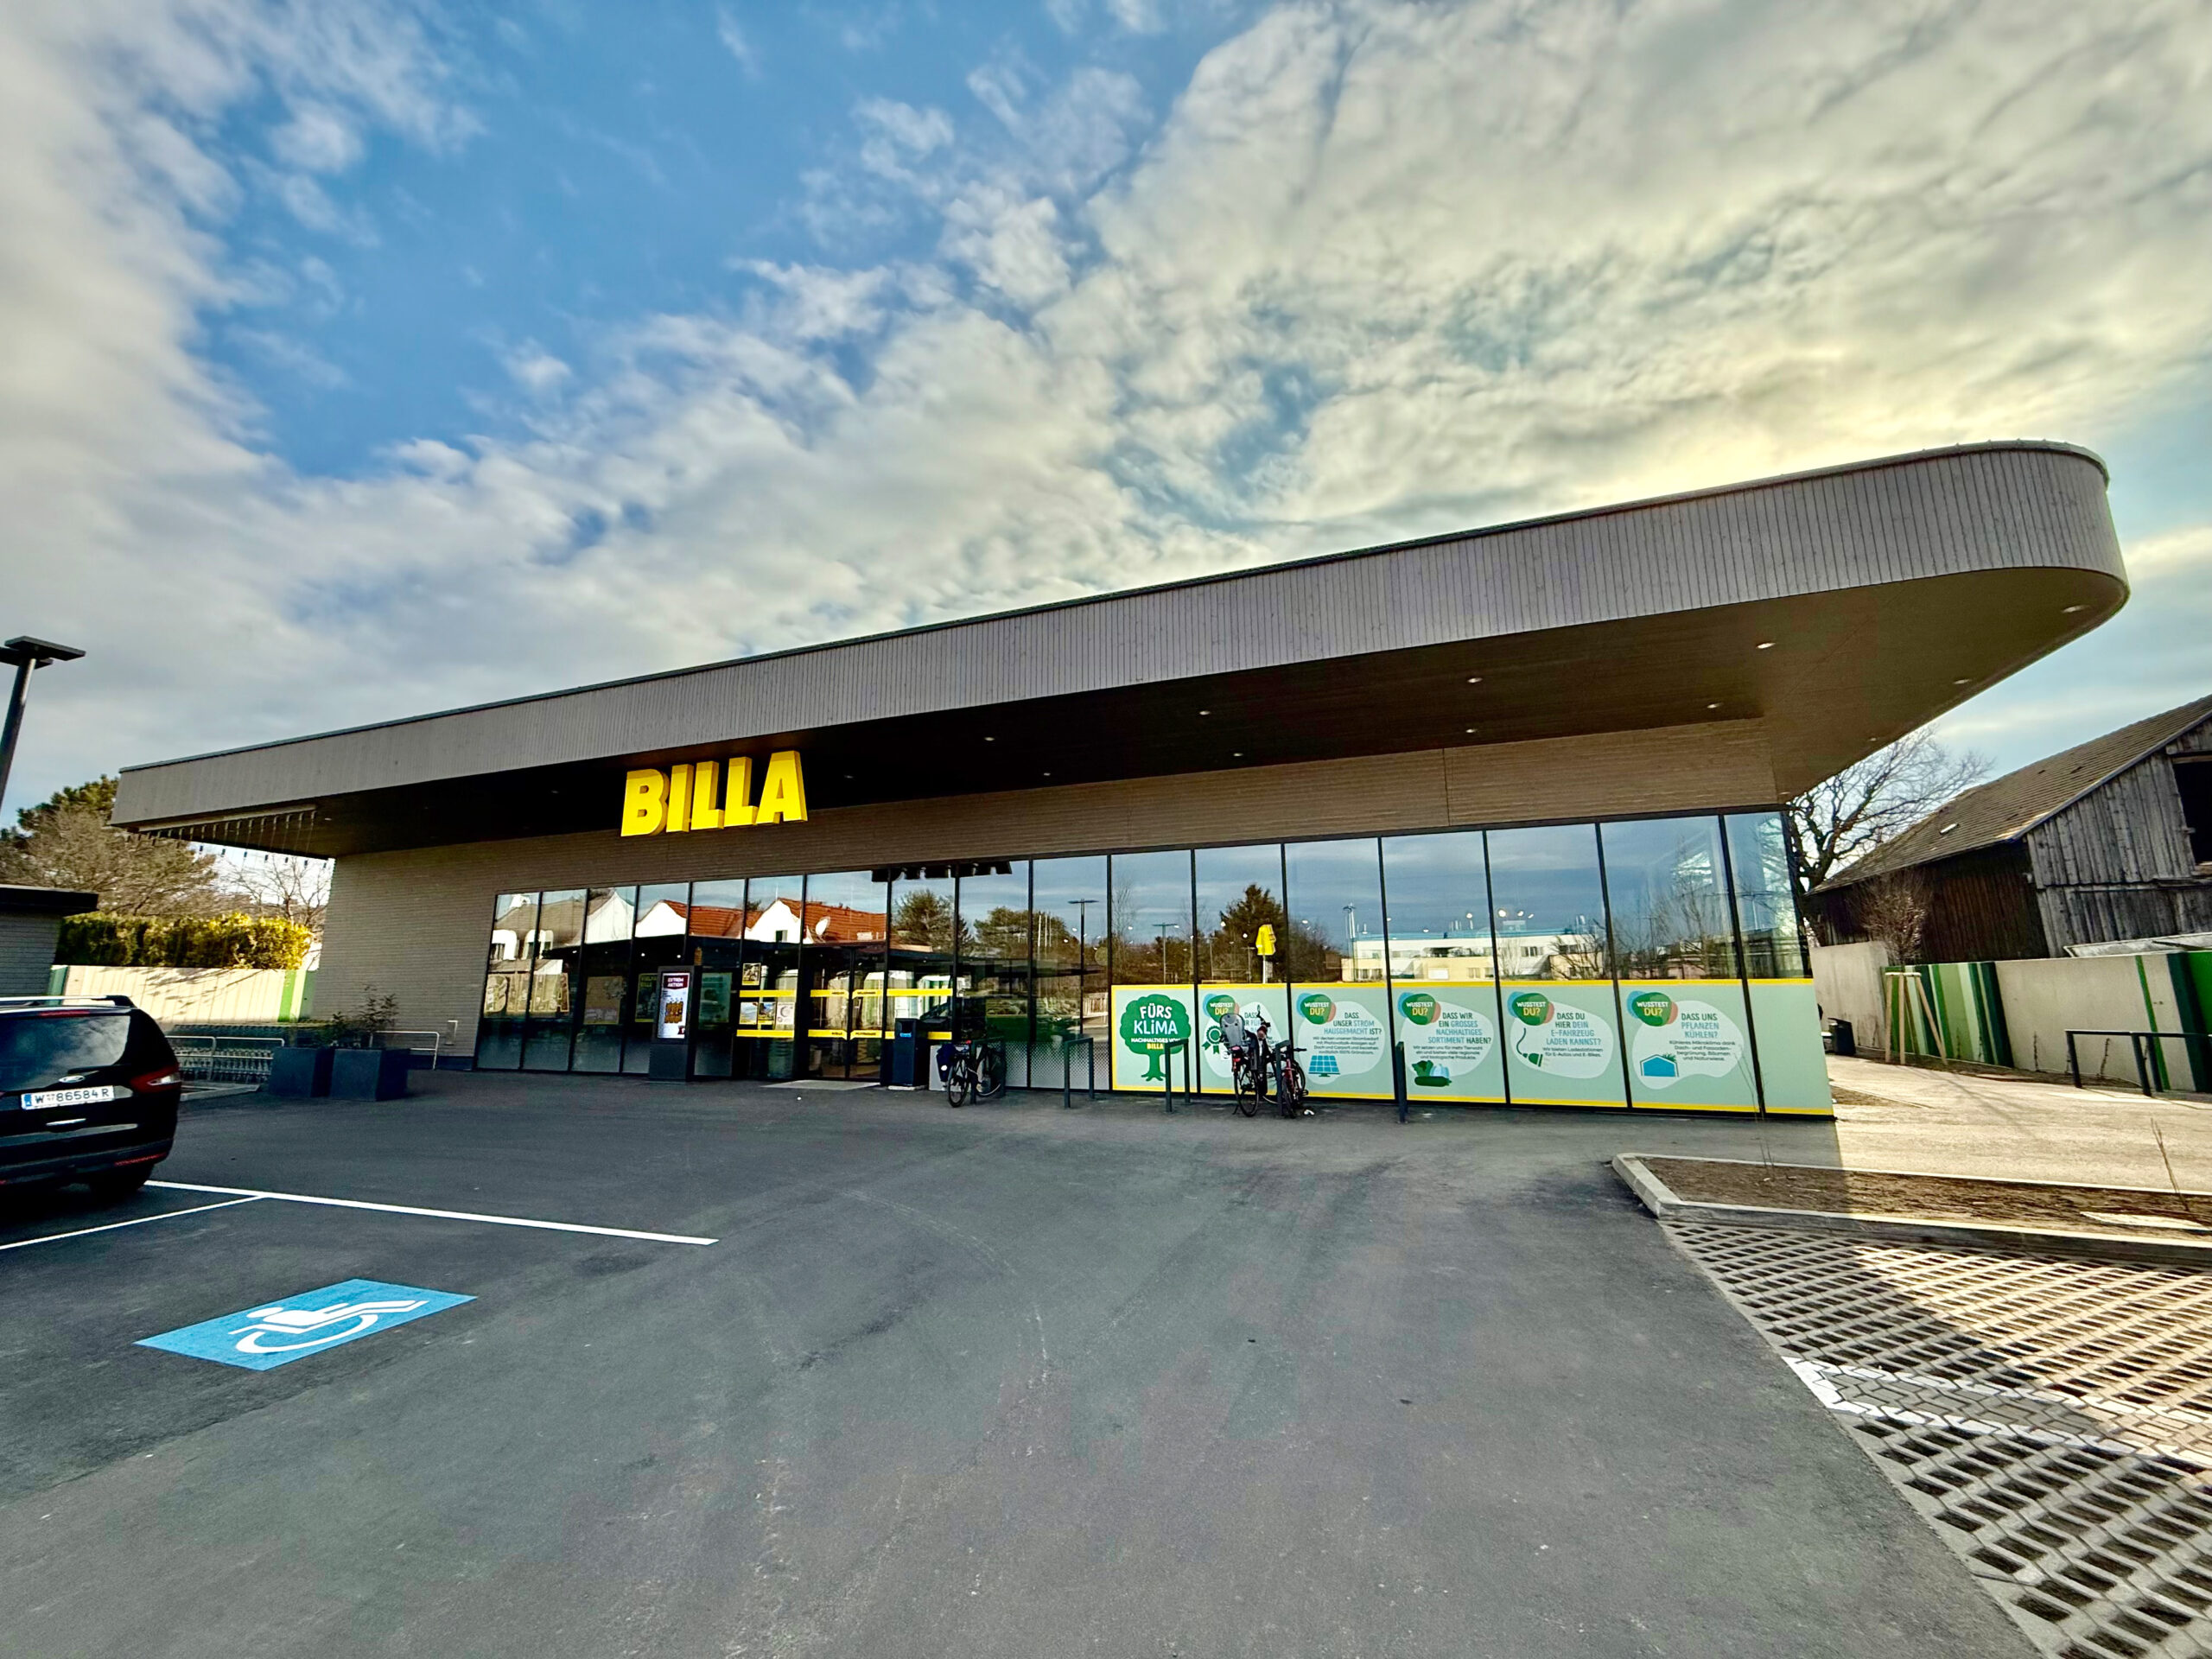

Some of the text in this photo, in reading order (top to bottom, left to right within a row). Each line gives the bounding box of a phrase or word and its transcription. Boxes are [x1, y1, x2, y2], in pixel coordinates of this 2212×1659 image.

[621, 750, 808, 836] BILLA
[1140, 1002, 1173, 1020] FÜRS
[1523, 1007, 1541, 1016] DU?
[1643, 1007, 1663, 1016] DU?
[1681, 1013, 1718, 1021] DASS UNS
[1681, 1021, 1719, 1030] PFLANZEN
[1684, 1029, 1718, 1039] KÜHLEN?
[35, 1088, 110, 1104] W 86584 R
